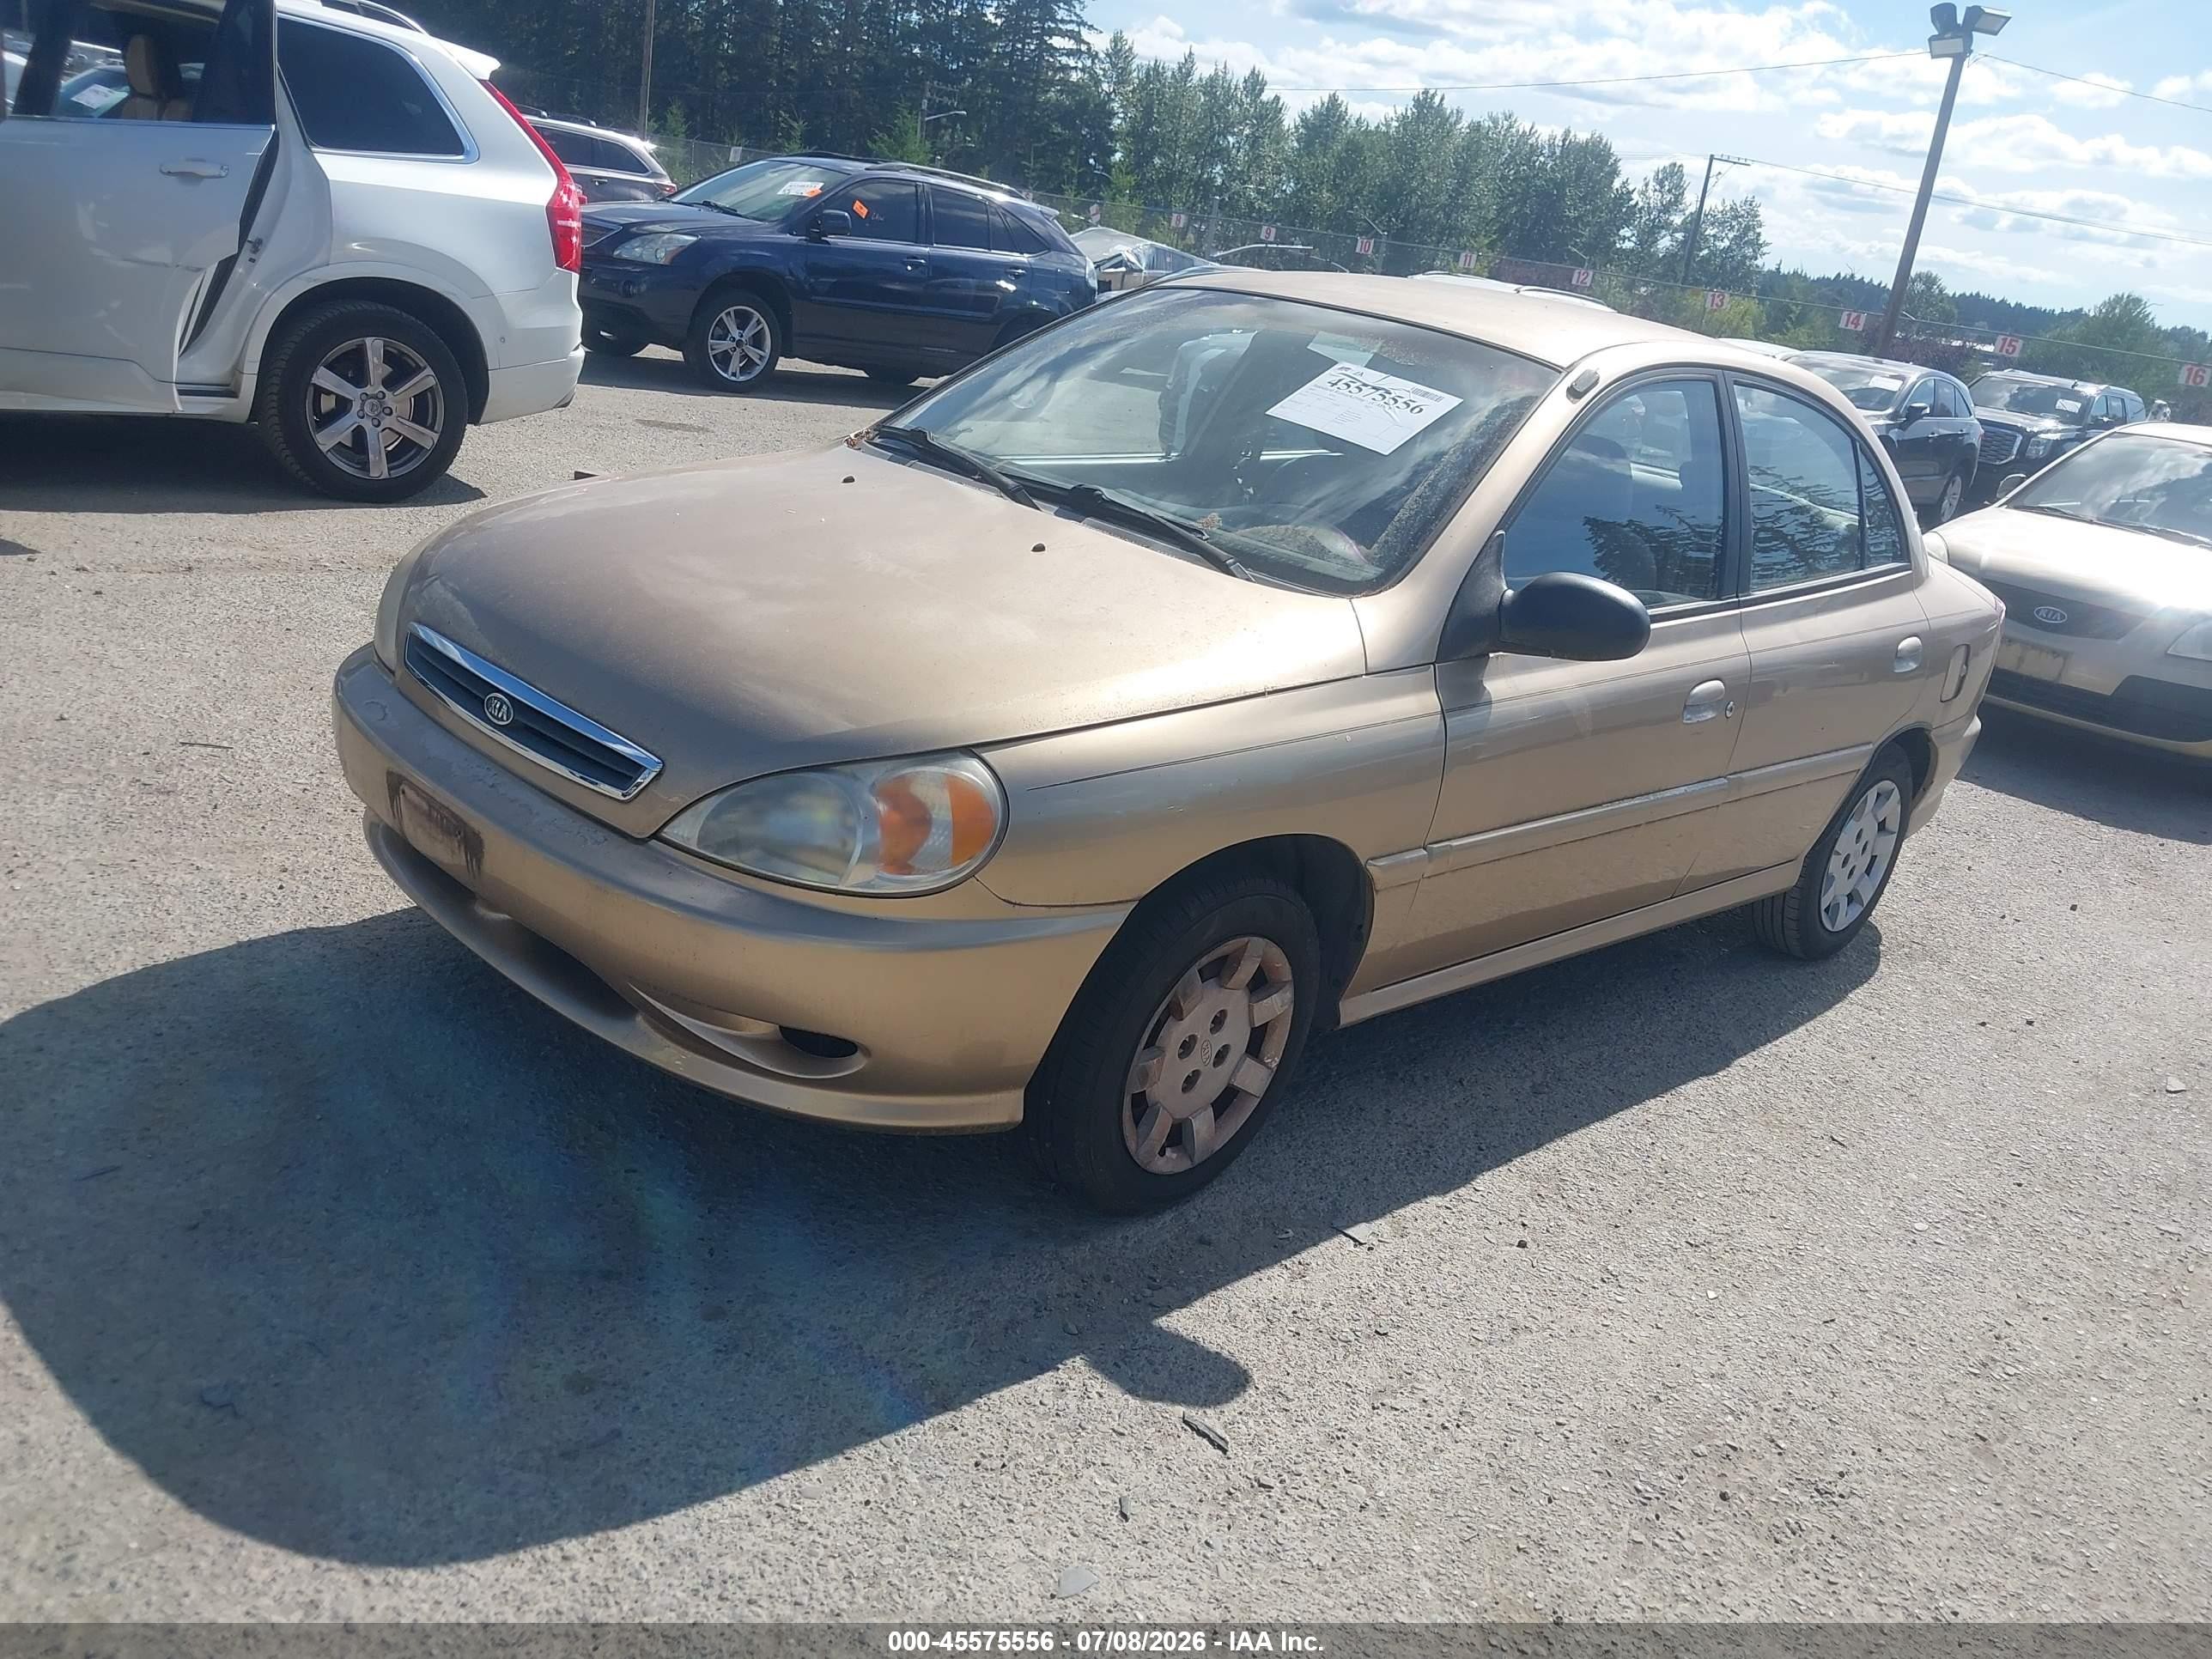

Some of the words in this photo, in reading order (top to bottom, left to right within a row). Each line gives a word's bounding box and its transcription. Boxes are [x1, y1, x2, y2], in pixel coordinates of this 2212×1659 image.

[1175, 214, 1182, 225] 8
[1264, 227, 1272, 240] 9
[1359, 240, 1370, 253] 10
[1463, 253, 1473, 267] 11
[1575, 270, 1589, 285] 12
[1710, 293, 1726, 308] 13
[1844, 313, 1862, 330] 14
[1997, 337, 2017, 356] 15
[2185, 367, 2205, 386] 16
[1327, 378, 1430, 415] 45575556
